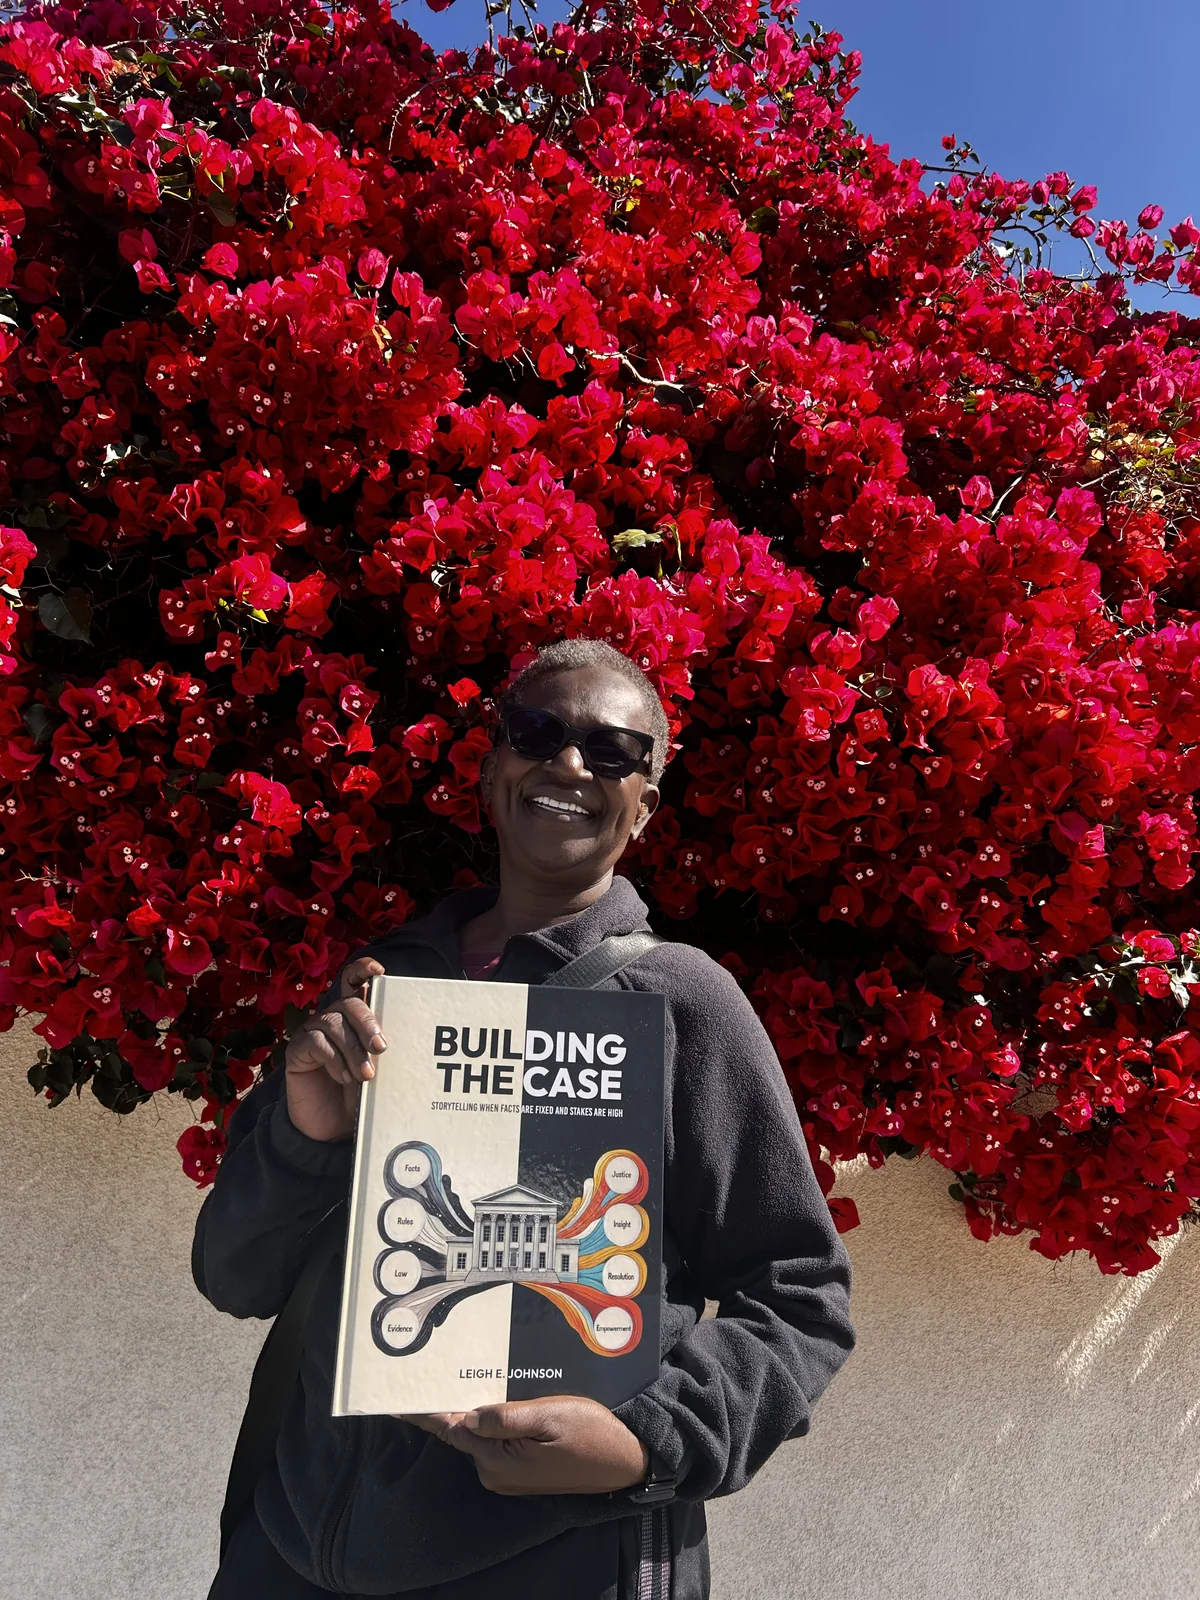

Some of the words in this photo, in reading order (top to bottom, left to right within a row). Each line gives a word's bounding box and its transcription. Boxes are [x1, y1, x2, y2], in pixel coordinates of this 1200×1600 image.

[433, 1025, 627, 1066] BUILDING
[436, 1062, 515, 1095] THE
[522, 1066, 623, 1100] CASE
[431, 1101, 478, 1112] STORYTELLING
[479, 1103, 499, 1113] WHEN
[500, 1104, 520, 1113] FACTS
[521, 1105, 534, 1114] ARE
[535, 1105, 554, 1115] FIXED
[555, 1106, 569, 1116] AND
[569, 1107, 593, 1117] STAKES
[594, 1107, 607, 1117] ARE
[607, 1108, 623, 1118] HIGH
[404, 1164, 421, 1173] Facts
[611, 1170, 632, 1179] Justice
[397, 1217, 414, 1226] Rules
[613, 1220, 632, 1230] Insight
[394, 1270, 408, 1278] Law
[607, 1272, 635, 1281] Resolution
[387, 1324, 413, 1333] Evidence
[596, 1324, 632, 1334] Empowerment
[459, 1368, 494, 1379] LEIGH
[496, 1369, 505, 1379] E.
[507, 1368, 563, 1379] JOHNSON
